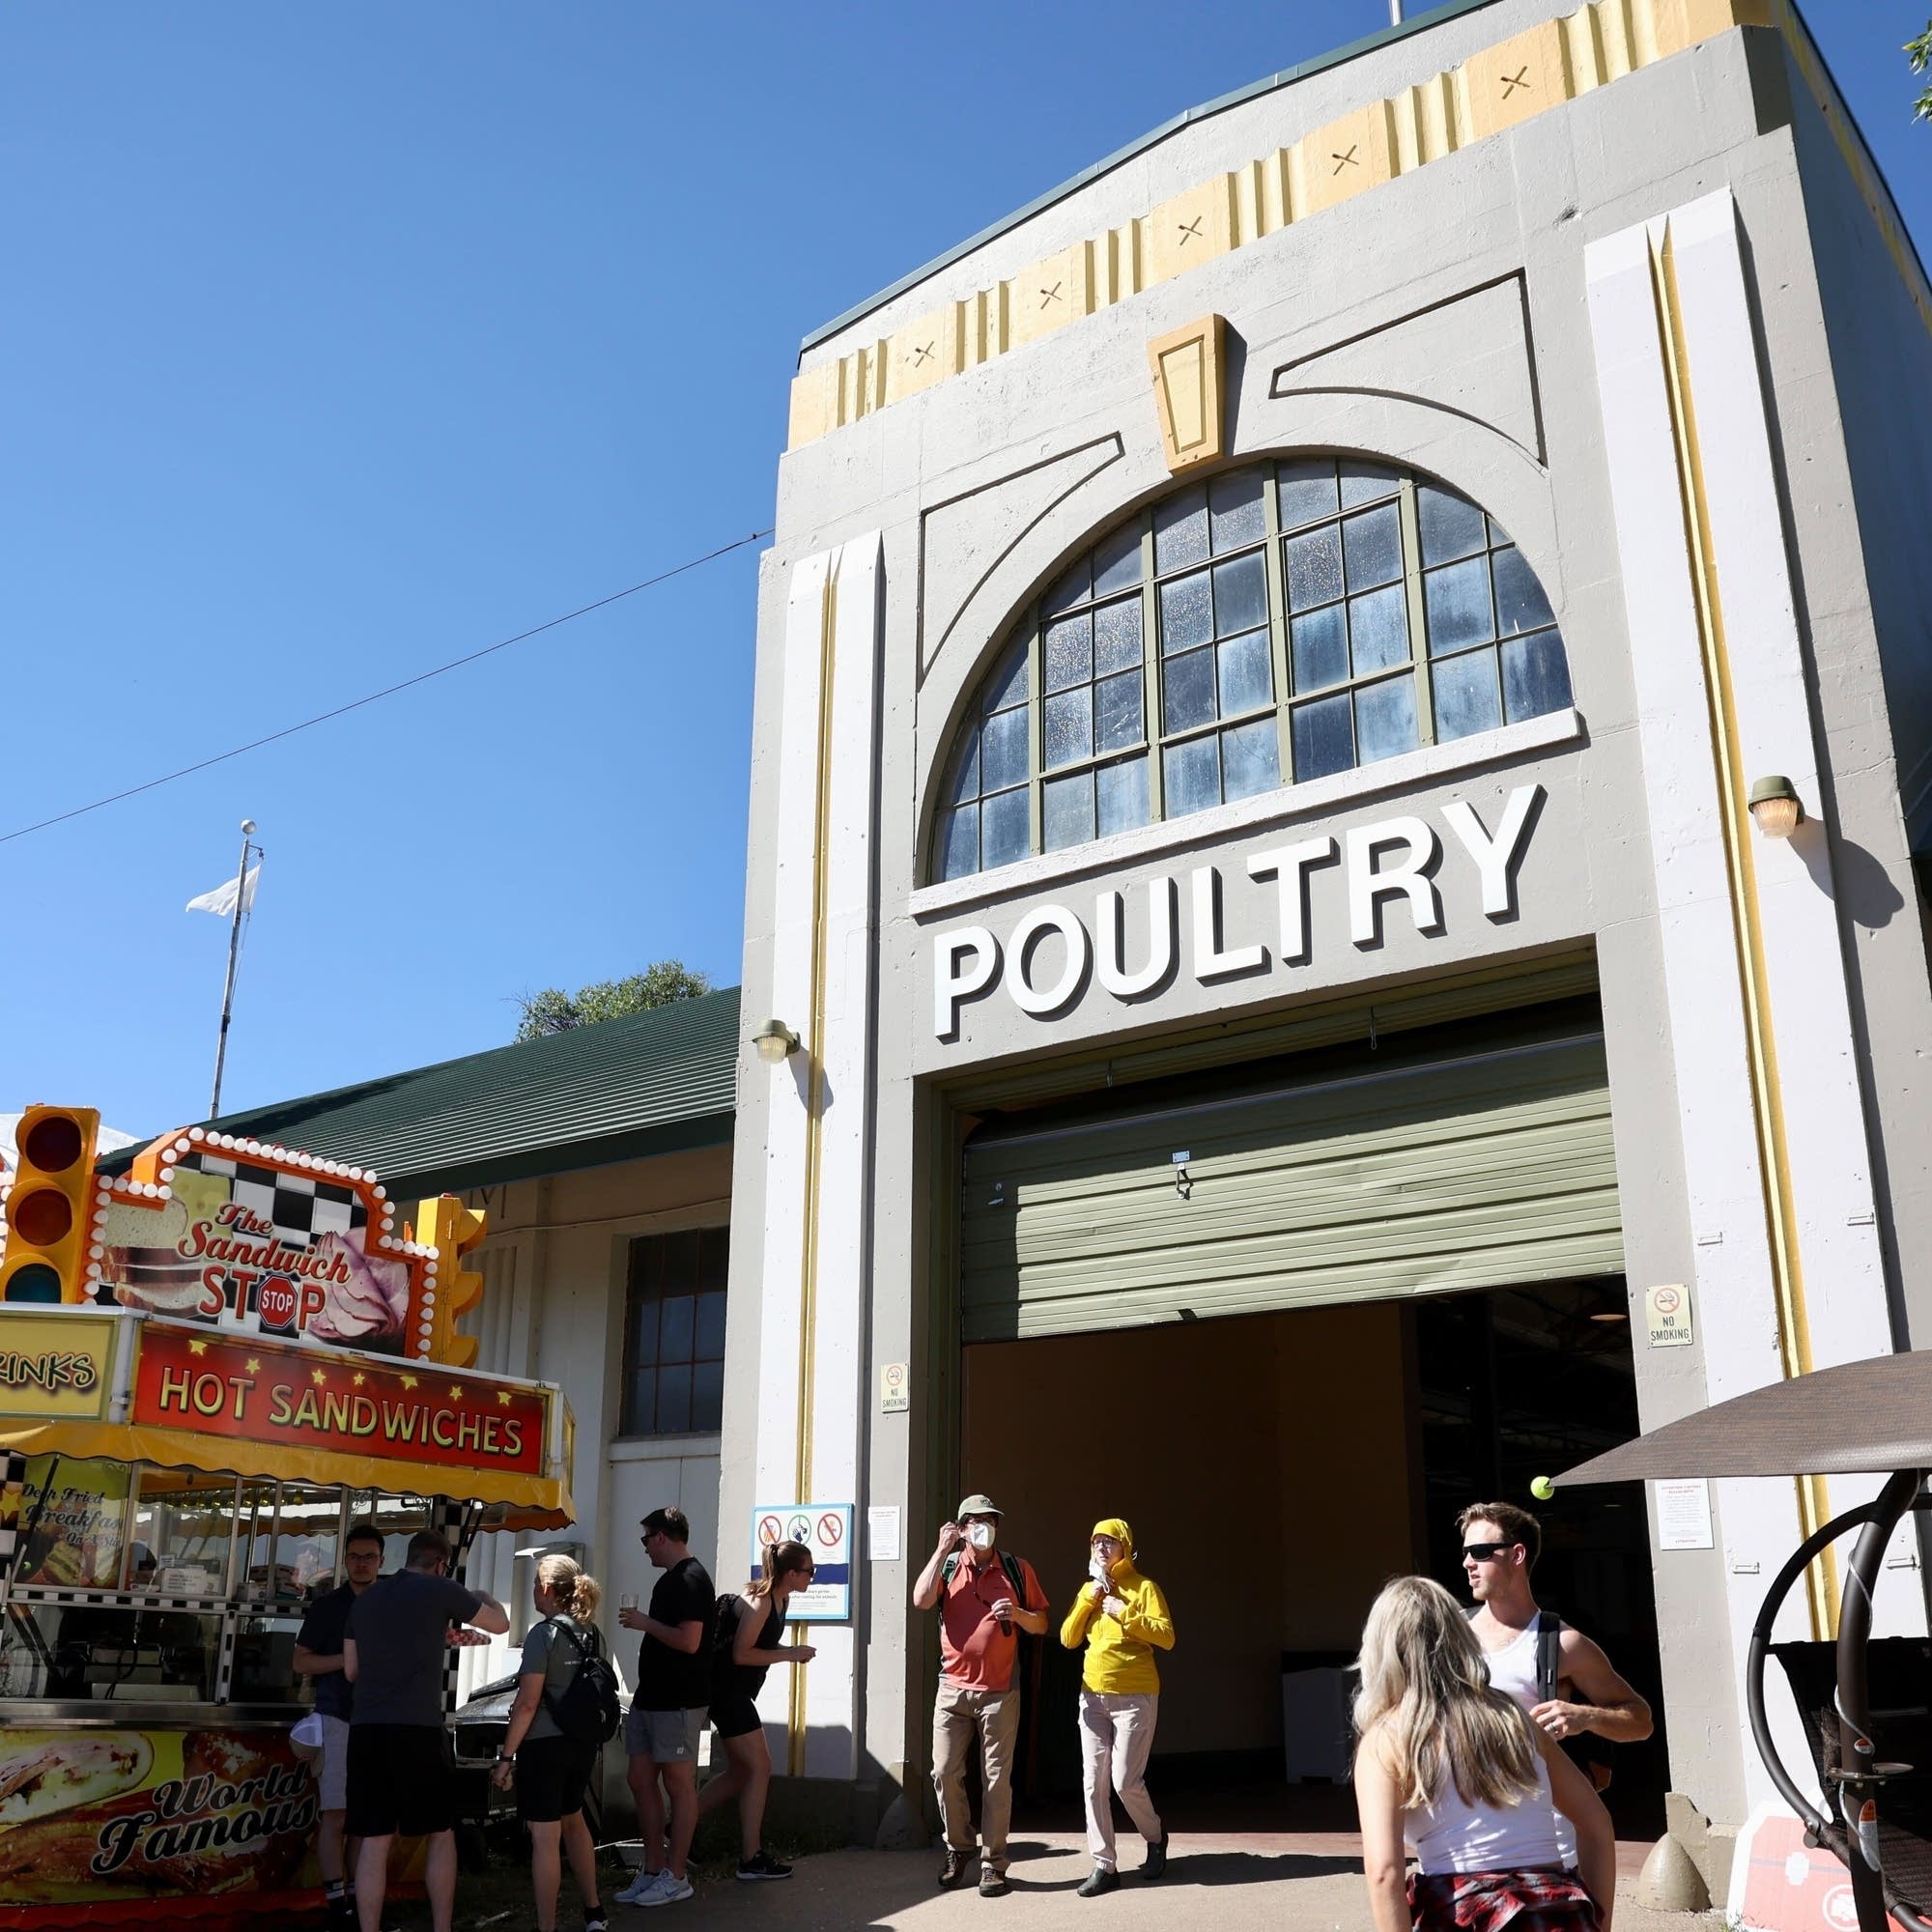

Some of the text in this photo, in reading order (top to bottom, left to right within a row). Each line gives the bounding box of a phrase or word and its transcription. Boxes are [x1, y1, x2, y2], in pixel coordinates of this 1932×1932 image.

[932, 783, 1548, 1041] POULTRY
[214, 1204, 273, 1234] The
[178, 1221, 351, 1284] Sandwich
[262, 1290, 294, 1313] STOP
[1662, 1316, 1675, 1327] NO
[1650, 1328, 1690, 1342] SMOKING
[159, 1367, 523, 1456] HOT SANDWICHES
[61, 1488, 105, 1504] Fried
[154, 1761, 311, 1818] World
[91, 1796, 316, 1874] Famous
